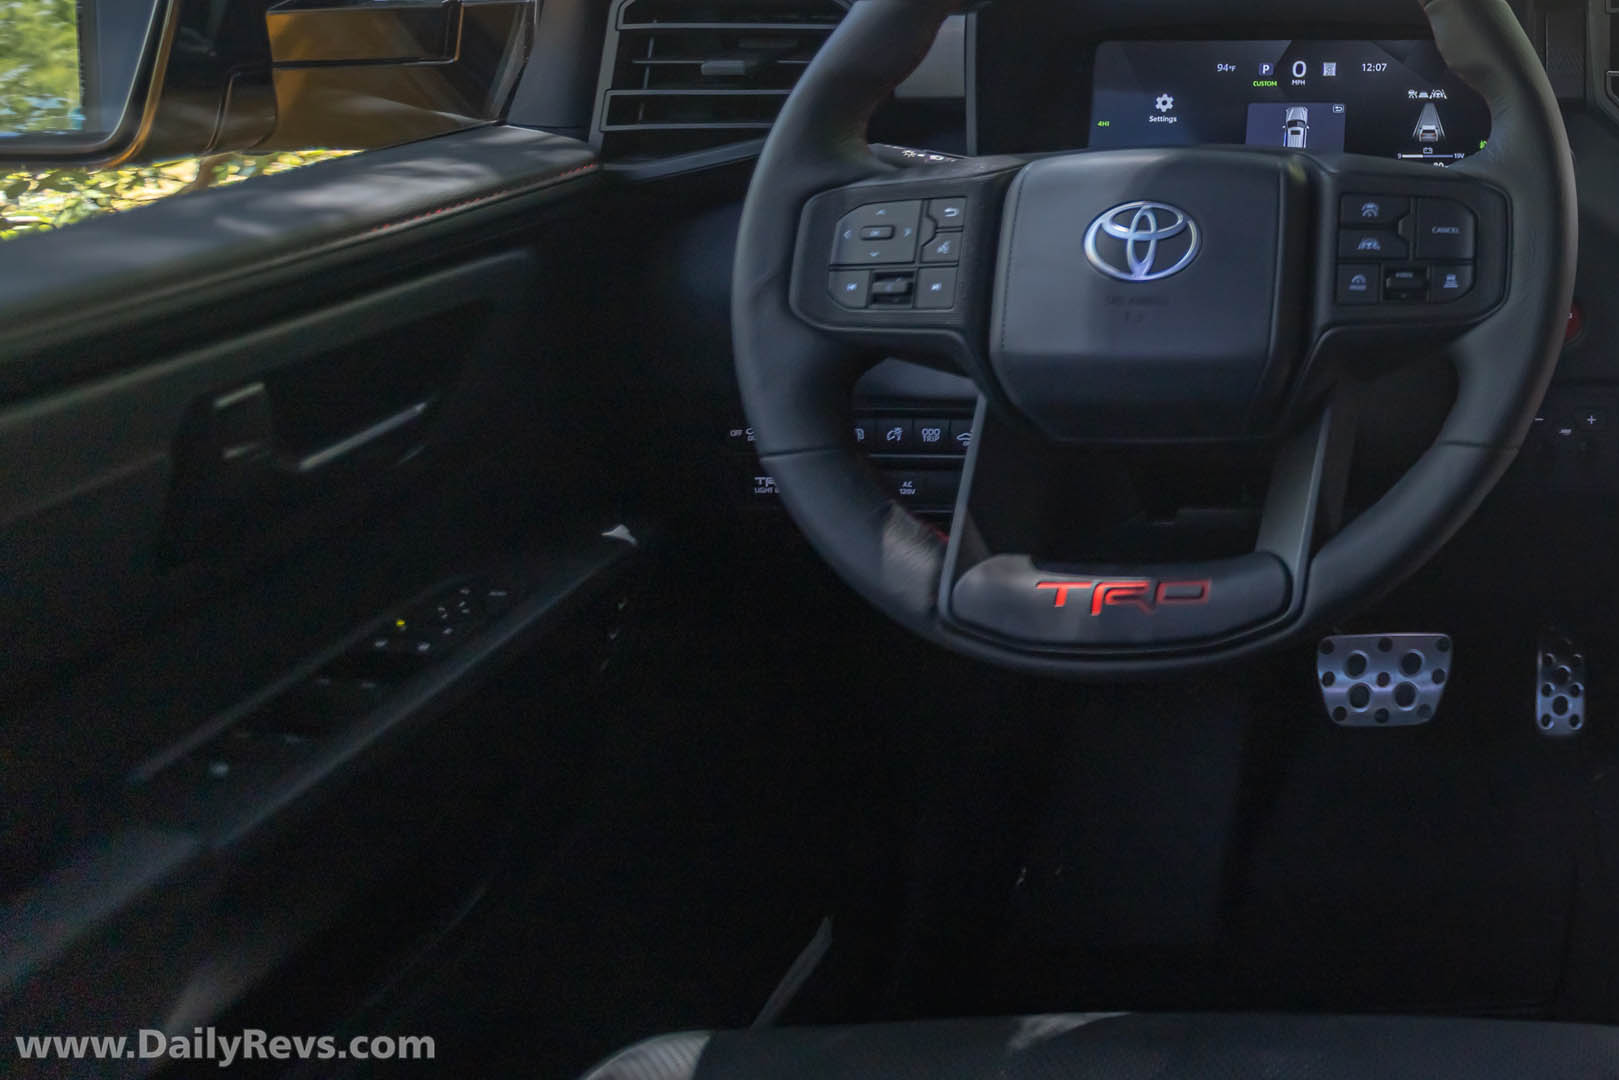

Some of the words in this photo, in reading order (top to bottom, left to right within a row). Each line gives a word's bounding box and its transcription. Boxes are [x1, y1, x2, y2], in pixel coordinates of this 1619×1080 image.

[1262, 64, 1270, 74] P
[1361, 63, 1388, 72] 12:07
[1149, 115, 1177, 124] Settings
[1035, 577, 1213, 617] TRD
